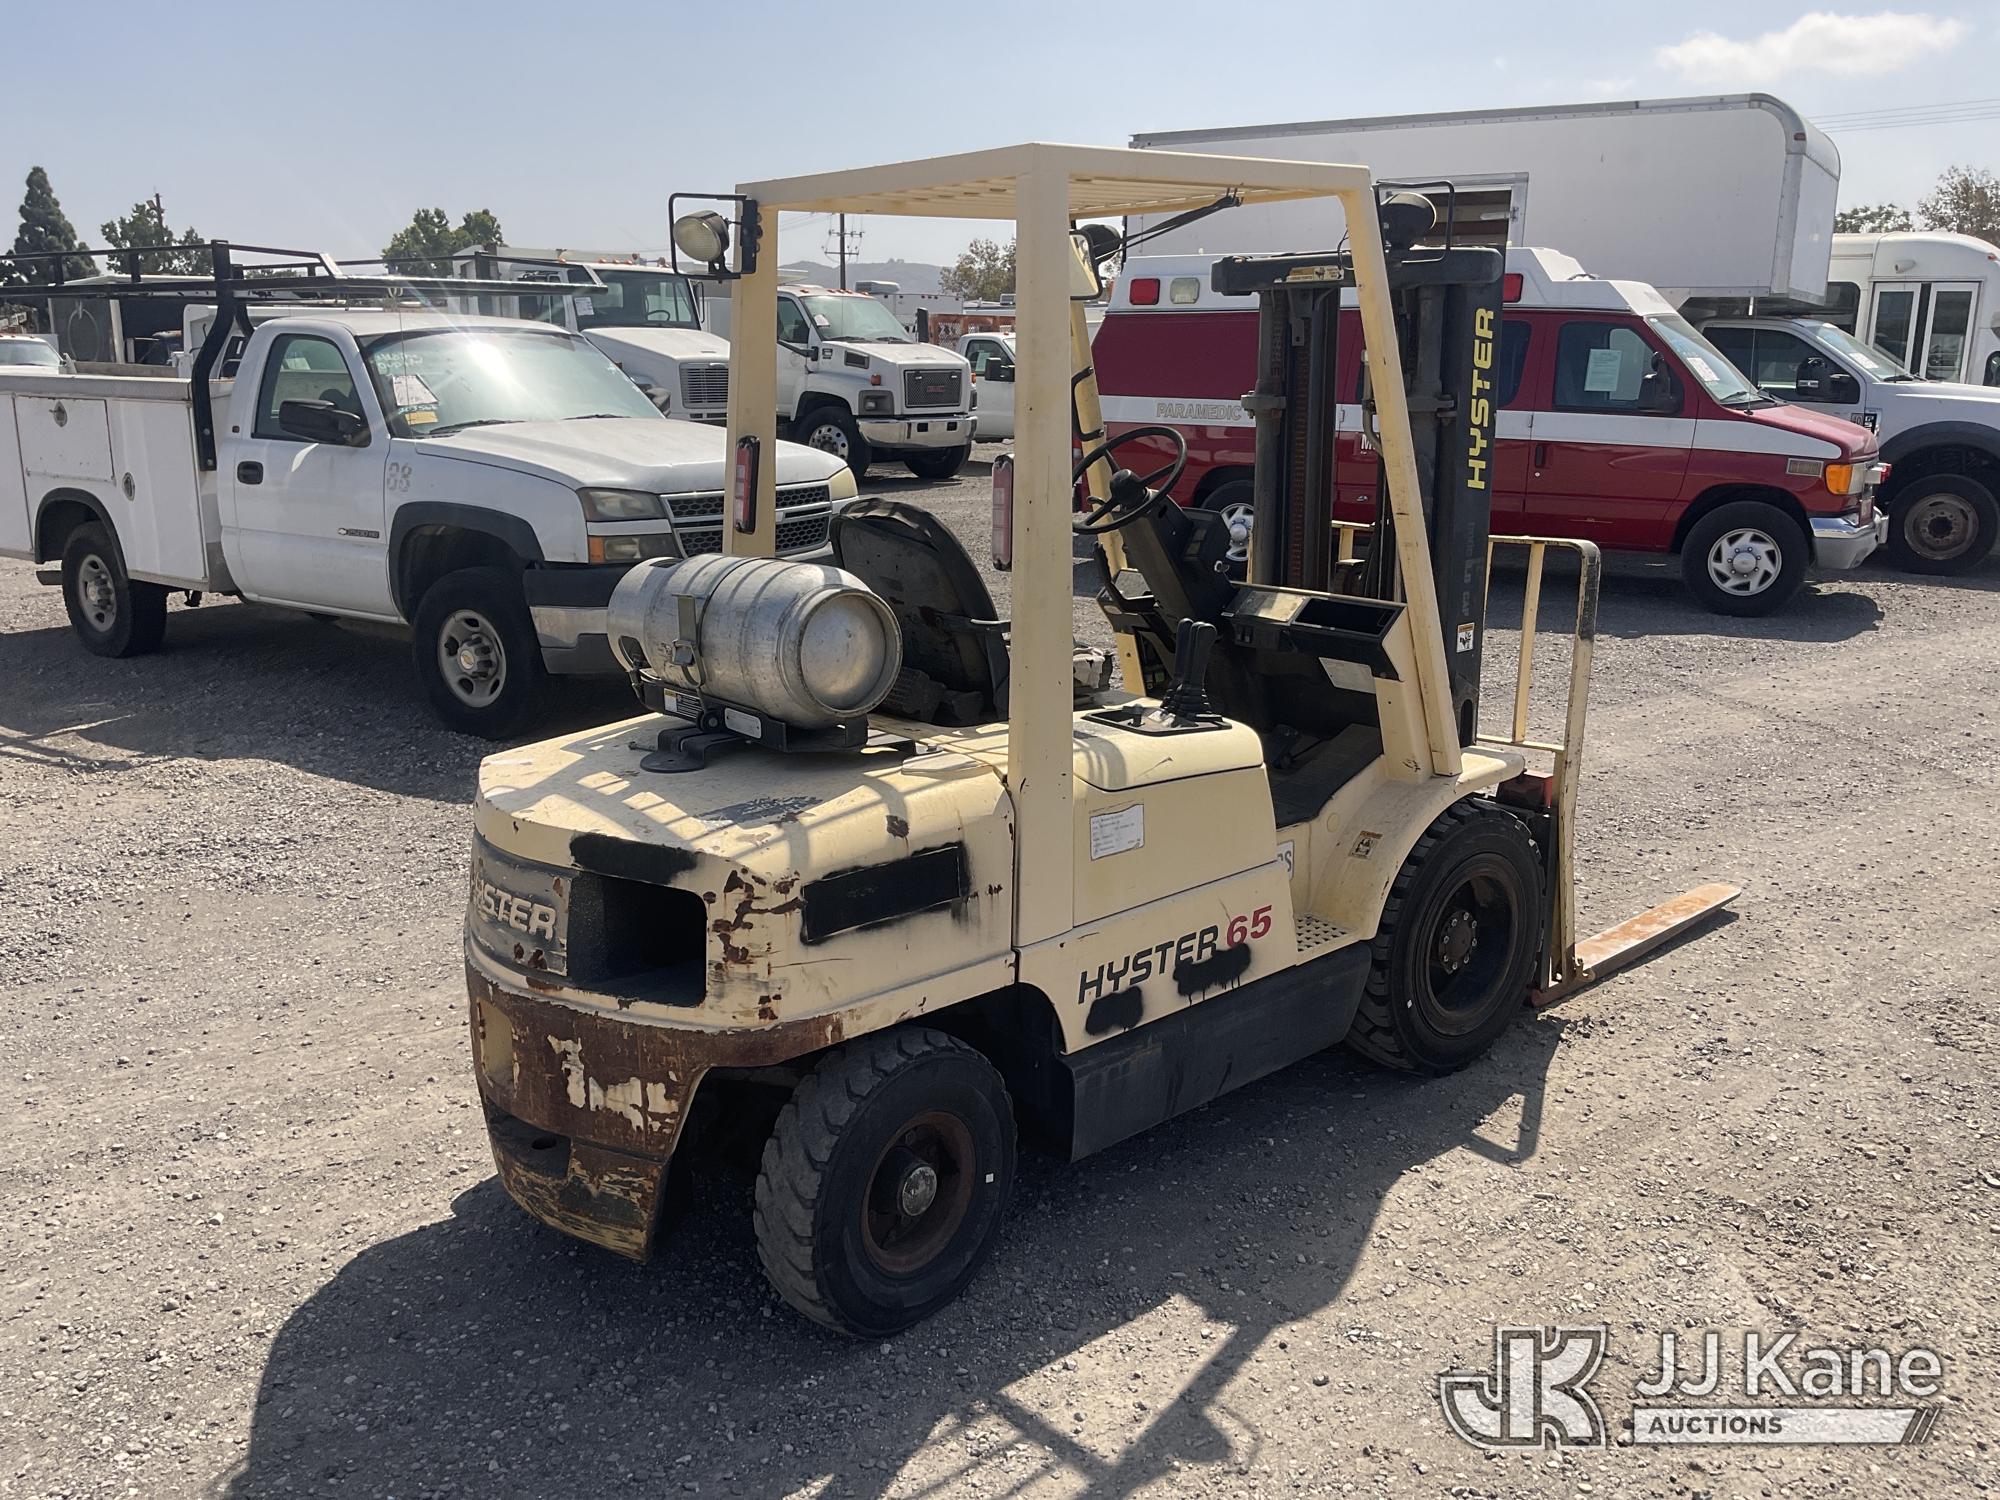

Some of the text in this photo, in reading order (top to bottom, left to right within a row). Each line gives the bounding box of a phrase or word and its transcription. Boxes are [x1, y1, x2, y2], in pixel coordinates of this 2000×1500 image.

[1156, 402, 1242, 421] PARAMEDIC
[1467, 308, 1494, 490] HYSTER
[1078, 904, 1273, 1005] HYSTER 65
